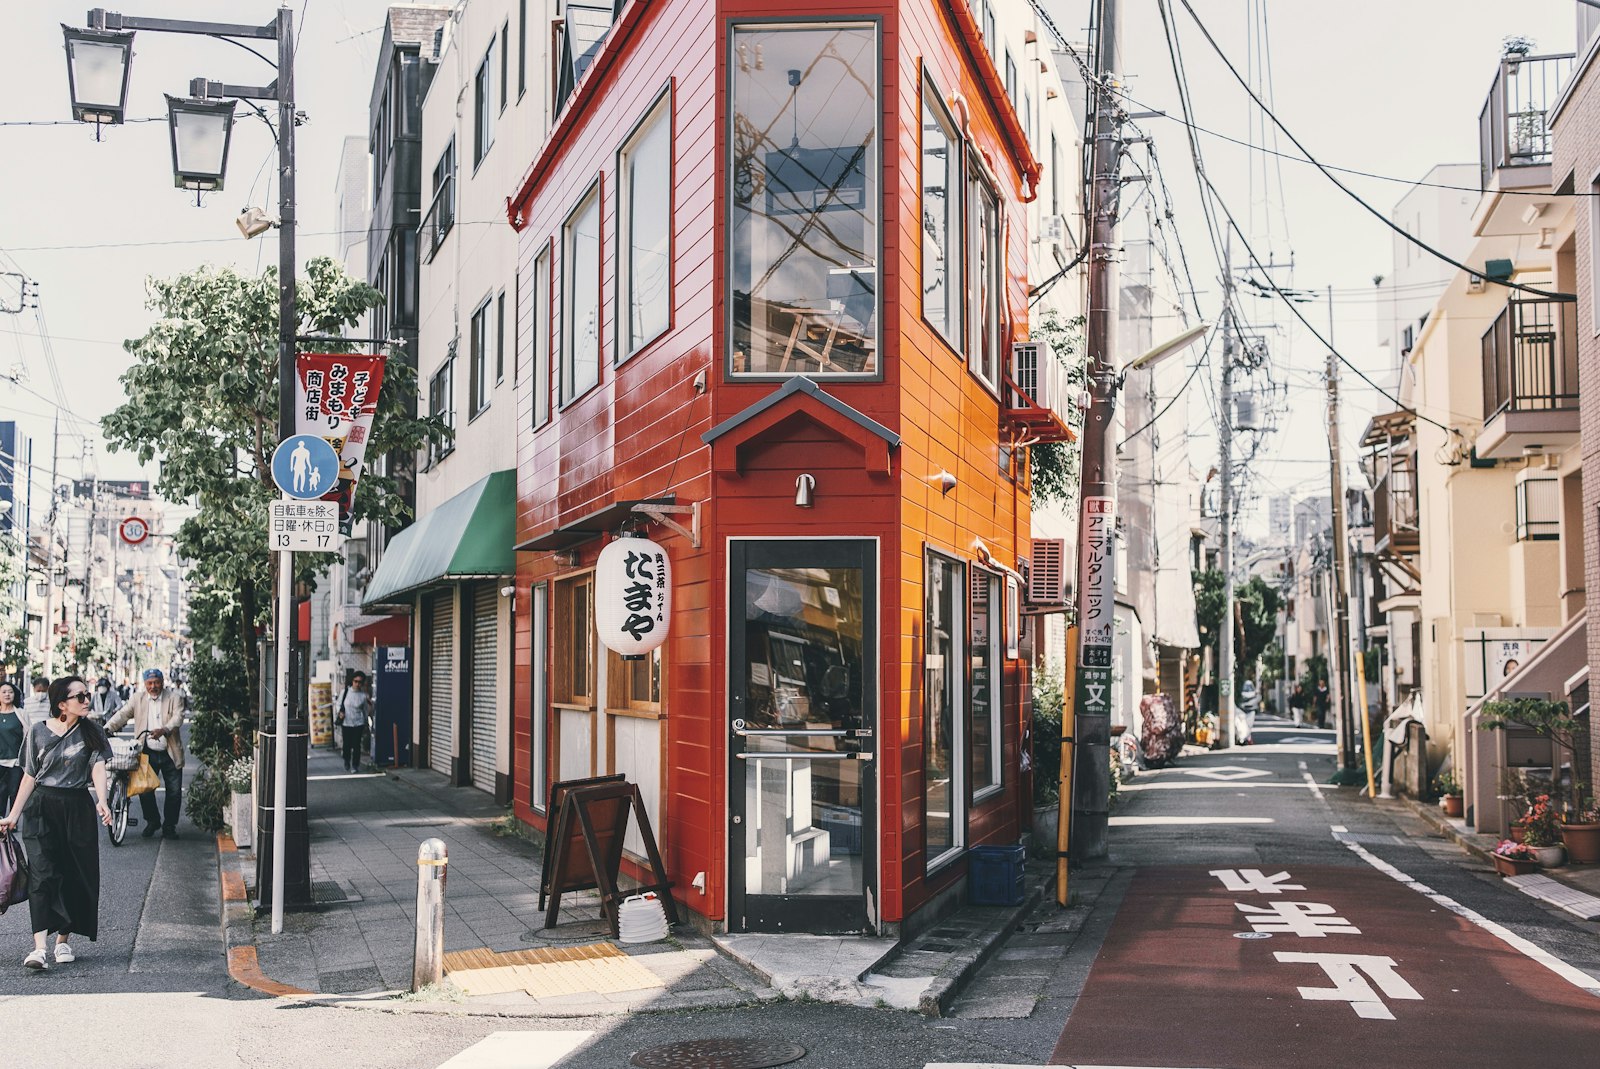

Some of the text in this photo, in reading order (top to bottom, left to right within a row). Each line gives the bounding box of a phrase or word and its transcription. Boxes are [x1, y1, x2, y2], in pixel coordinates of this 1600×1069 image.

[305, 371, 323, 421] 商店街
[327, 364, 347, 430] みまもり
[350, 372, 369, 419] 子ども
[126, 523, 143, 537] 30
[274, 504, 335, 517] 自転車を除く
[277, 534, 290, 547] 13
[317, 535, 330, 547] 17
[621, 550, 655, 641] たまや
[1084, 681, 1106, 705] 文
[1208, 868, 1425, 1021] 止まれ
